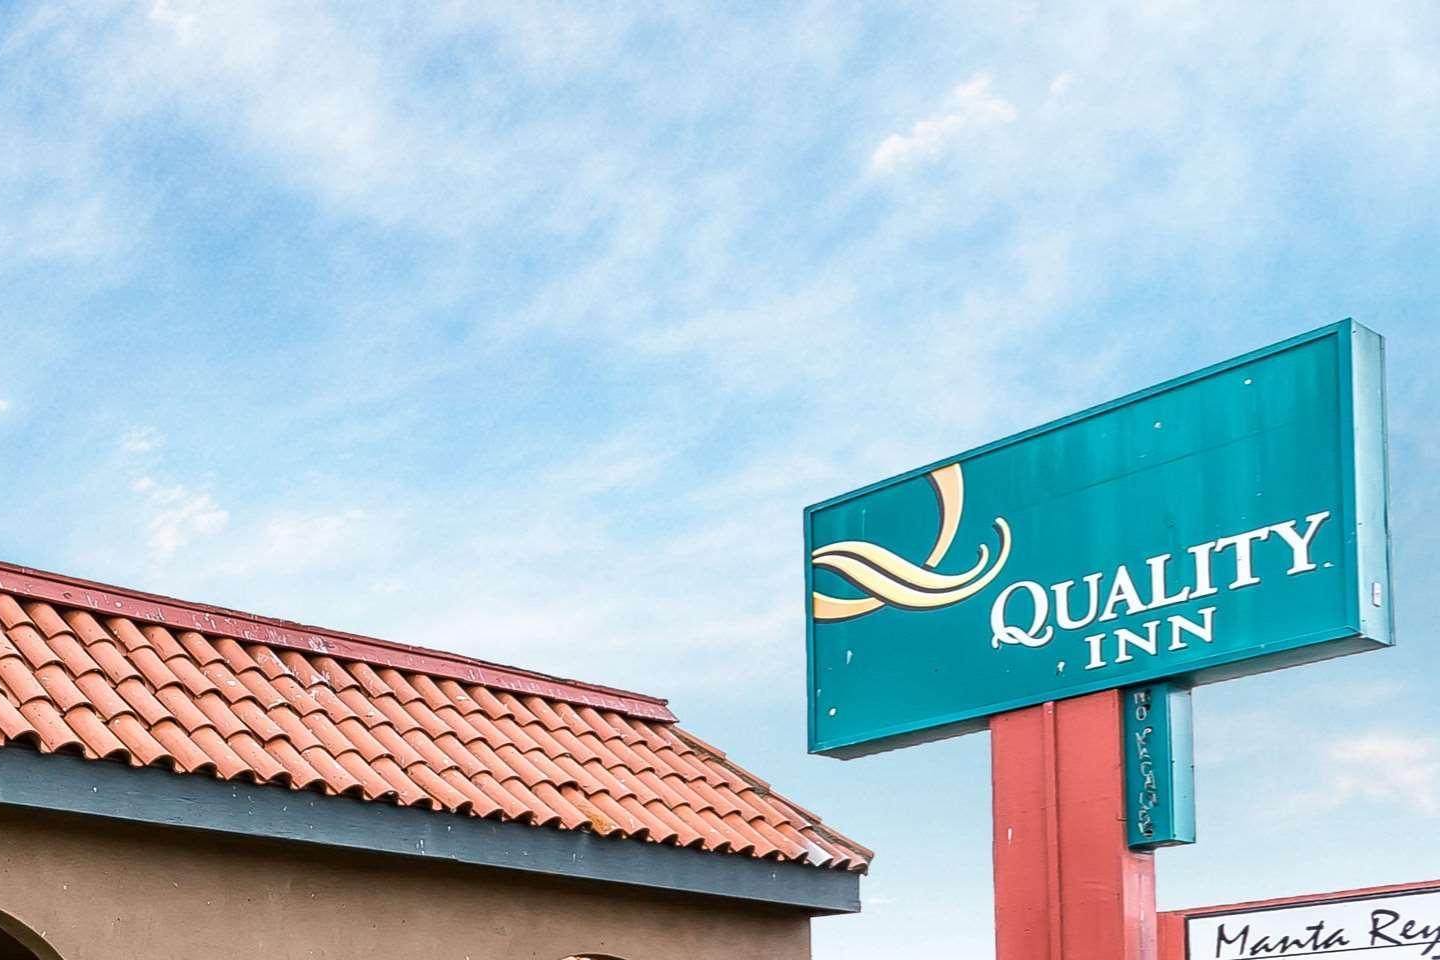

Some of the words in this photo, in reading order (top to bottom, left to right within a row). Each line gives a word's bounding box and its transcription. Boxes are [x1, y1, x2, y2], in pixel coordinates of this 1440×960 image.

[990, 511, 1331, 649] QUALITY
[1085, 607, 1216, 670] INN
[1215, 920, 1351, 959] Manta
